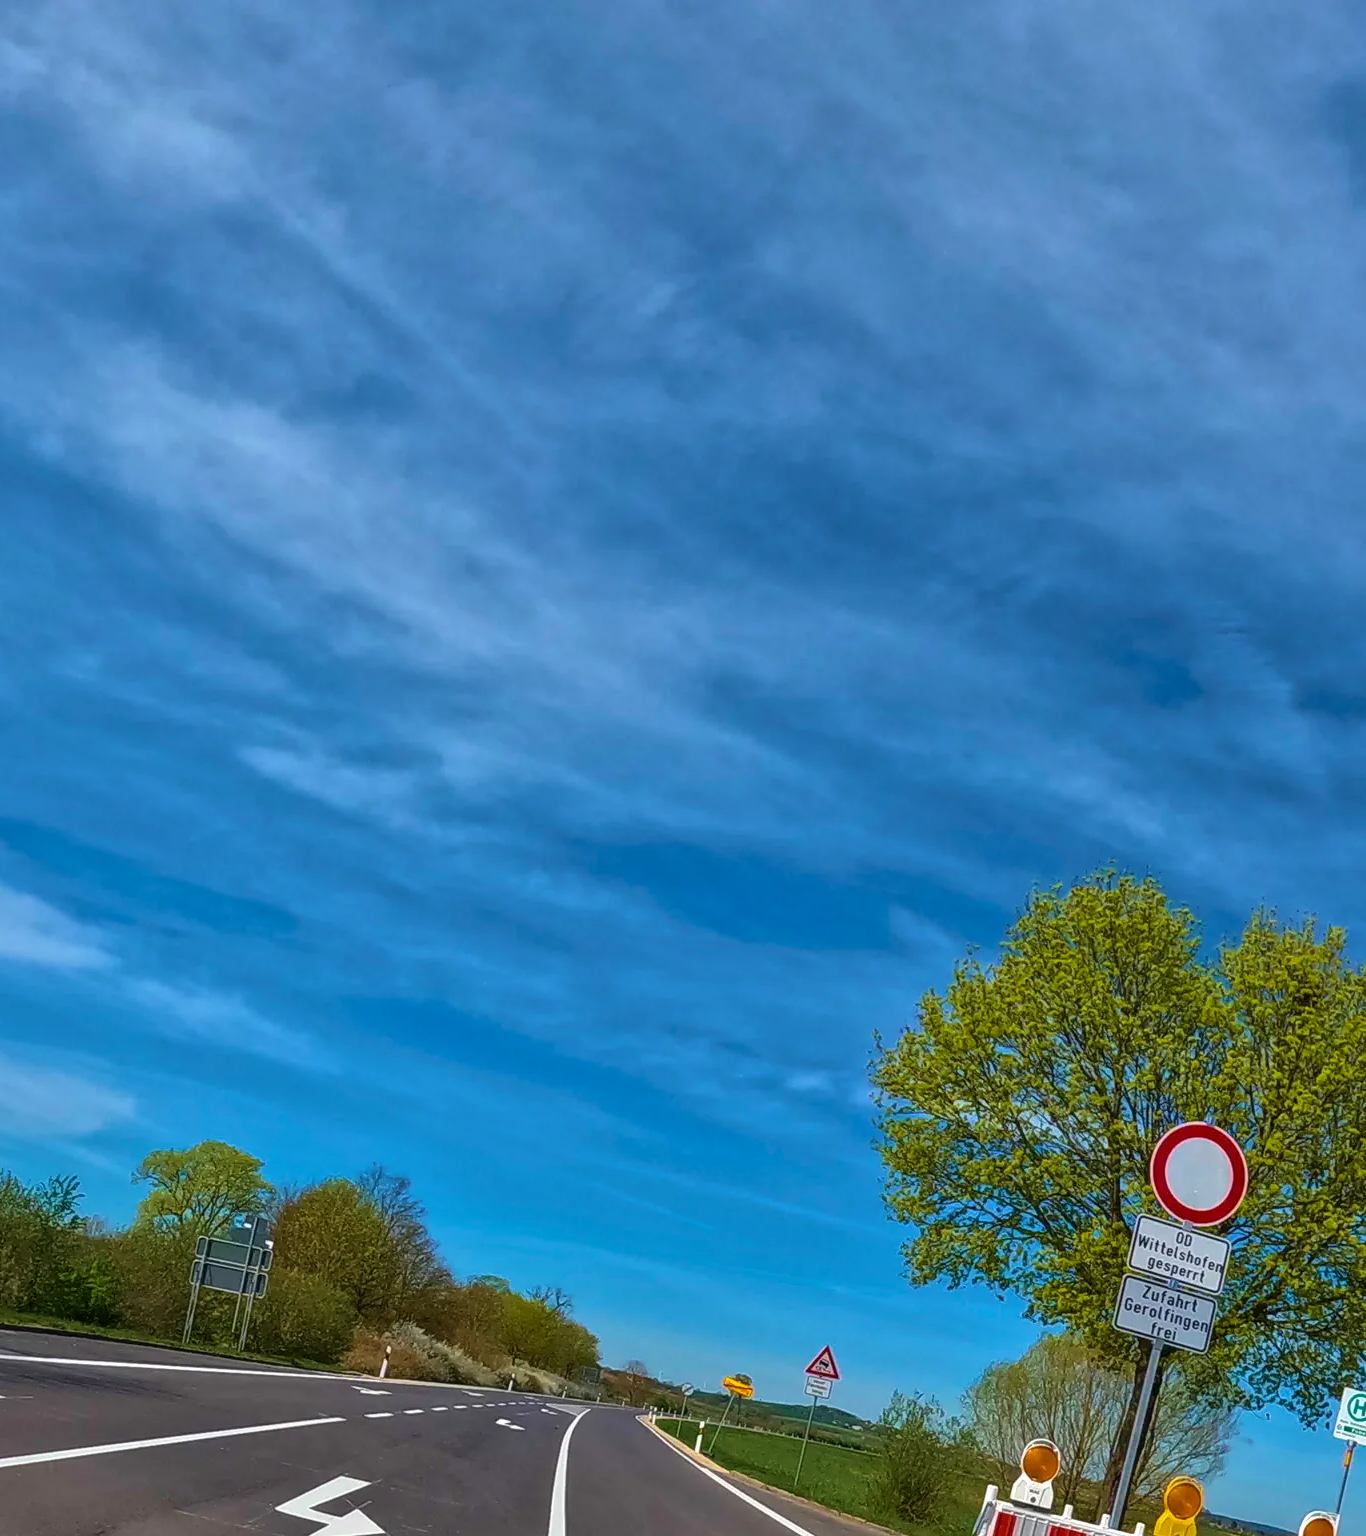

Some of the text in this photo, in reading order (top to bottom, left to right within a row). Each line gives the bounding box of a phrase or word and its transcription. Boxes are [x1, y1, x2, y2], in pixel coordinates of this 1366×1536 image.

[1138, 1233, 1224, 1274] Wittelshofen
[1147, 1257, 1205, 1283] gesperrt
[1142, 1285, 1198, 1313] Zufahrt
[1124, 1297, 1209, 1333] Gerolfingen
[1151, 1322, 1177, 1340] frei
